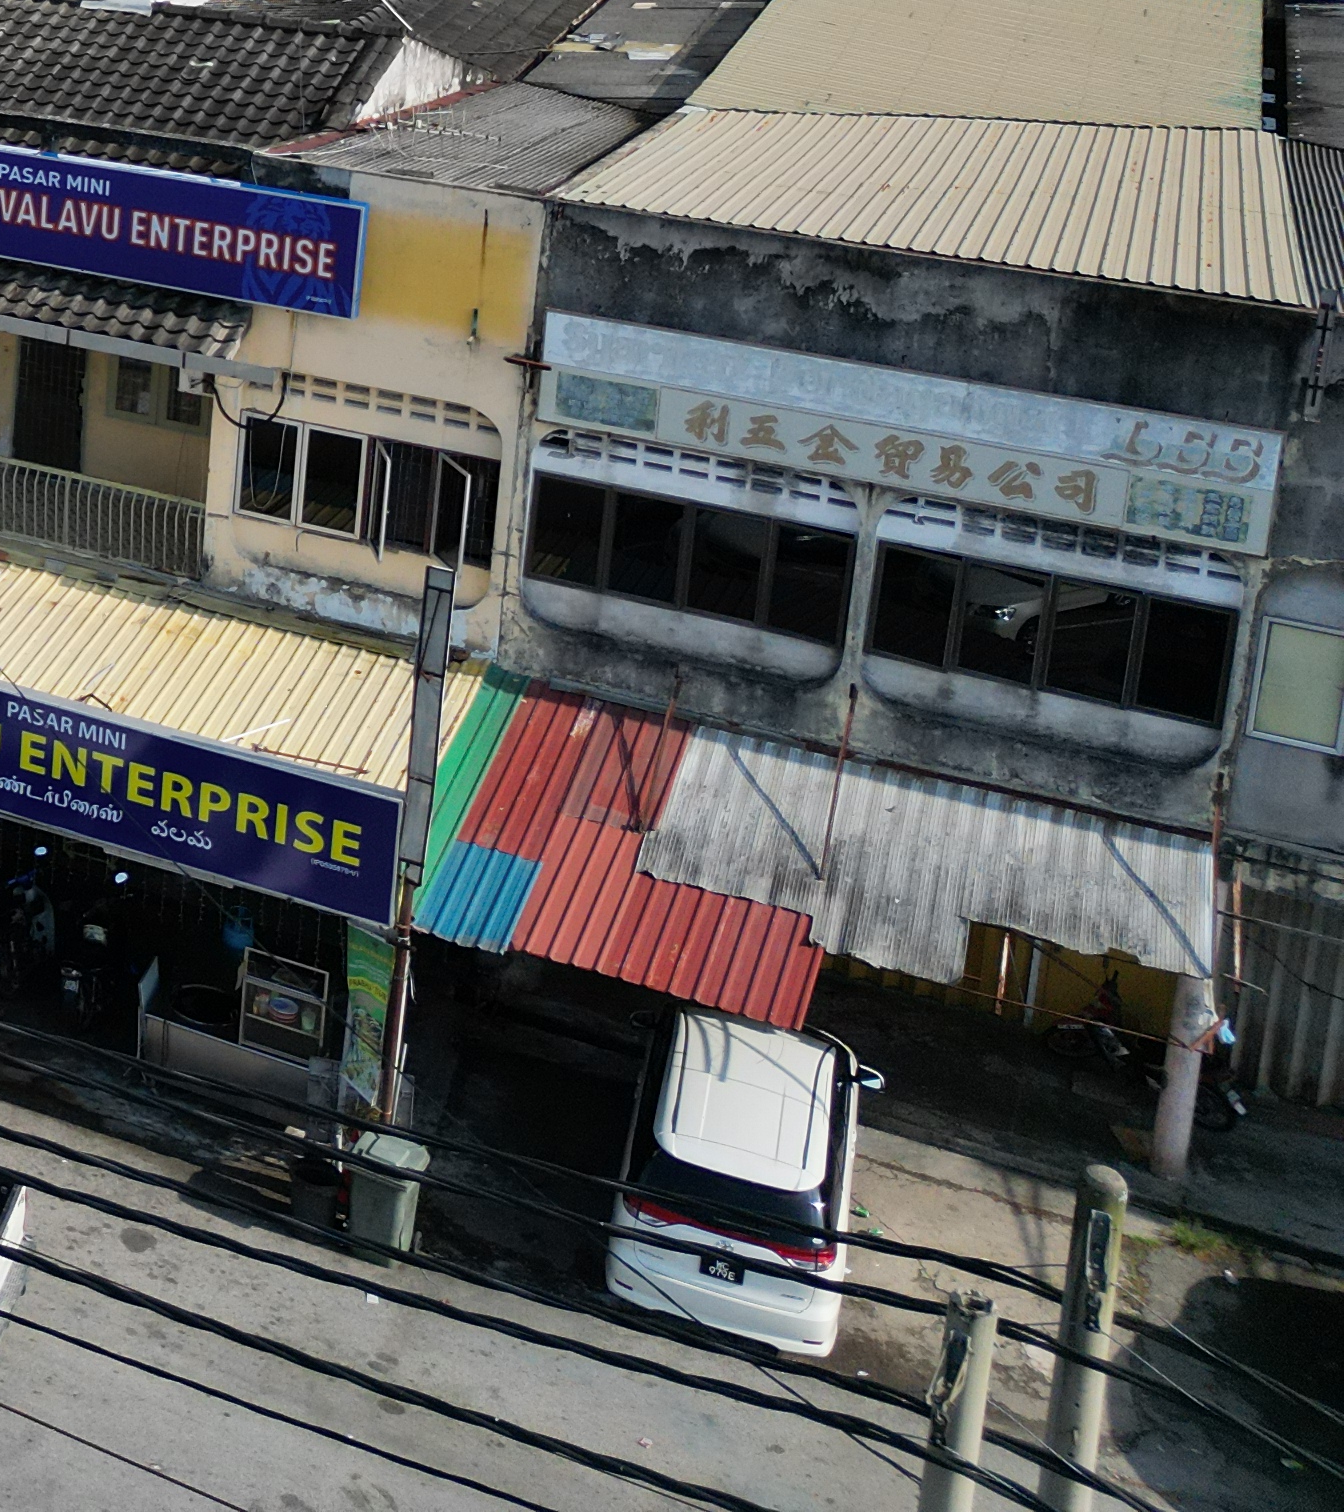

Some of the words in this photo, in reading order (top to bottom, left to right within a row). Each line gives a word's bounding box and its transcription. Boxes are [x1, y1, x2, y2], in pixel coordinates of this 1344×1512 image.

[66, 173, 110, 197] MINI
[130, 210, 336, 279] ENTERPRISE
[6, 700, 74, 736] PASAR
[78, 717, 127, 751] MINI
[18, 729, 362, 868] ENTERPRISE
[708, 1265, 735, 1281] 979E
